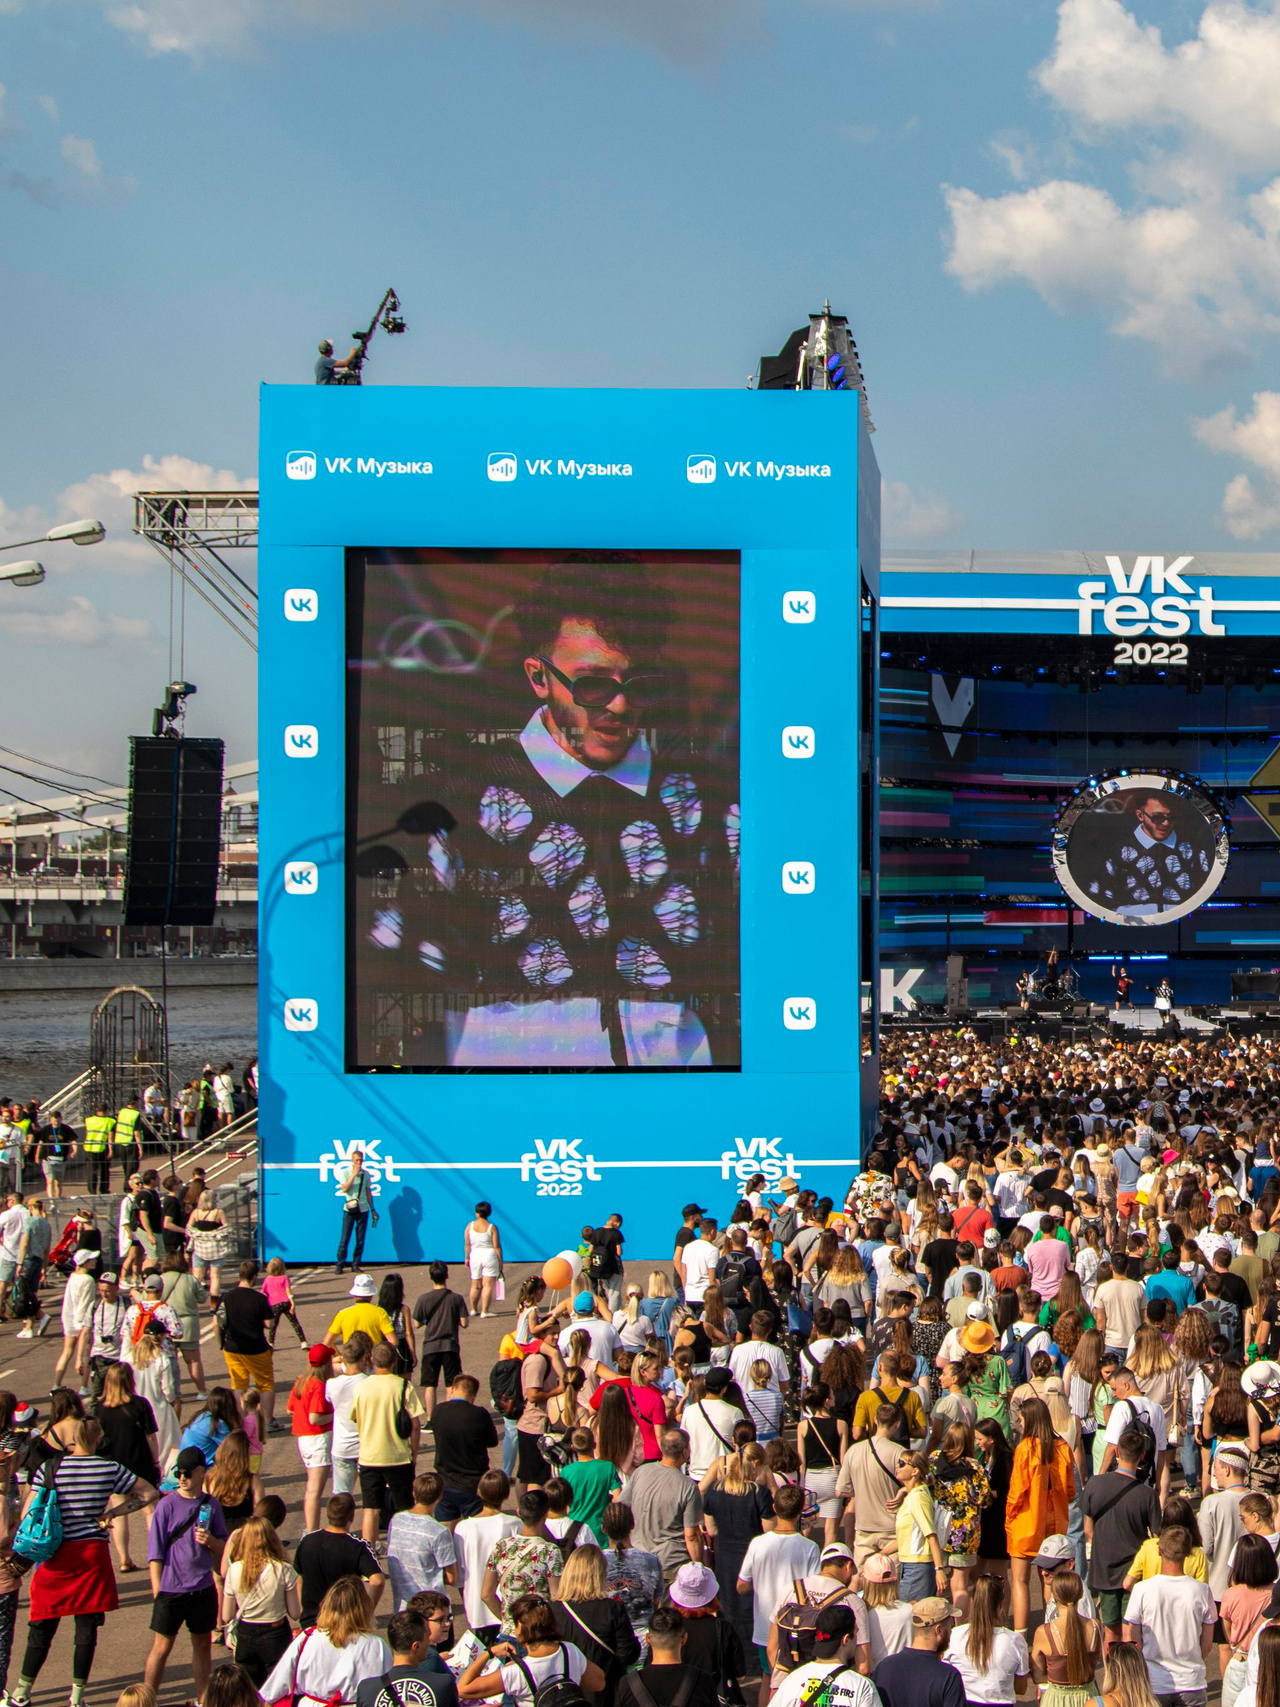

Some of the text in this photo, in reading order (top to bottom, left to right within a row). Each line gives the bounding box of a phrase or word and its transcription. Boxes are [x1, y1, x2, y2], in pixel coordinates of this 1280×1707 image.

[325, 457, 433, 478] VK Музыка
[525, 459, 633, 480] VK Музыка
[725, 461, 831, 481] VK Музыка
[1104, 555, 1196, 594] VK
[1078, 582, 1226, 637] fest
[1114, 642, 1189, 665] 2022
[872, 968, 925, 1013] K
[333, 1139, 382, 1160] VK
[534, 1139, 584, 1159] VK
[734, 1137, 783, 1157] VK
[521, 1153, 602, 1182] fest
[721, 1151, 802, 1180] fest
[335, 1183, 382, 1197] 22
[536, 1183, 583, 1196] 2022
[737, 1182, 783, 1194] 222
[825, 1695, 834, 1703] TO
